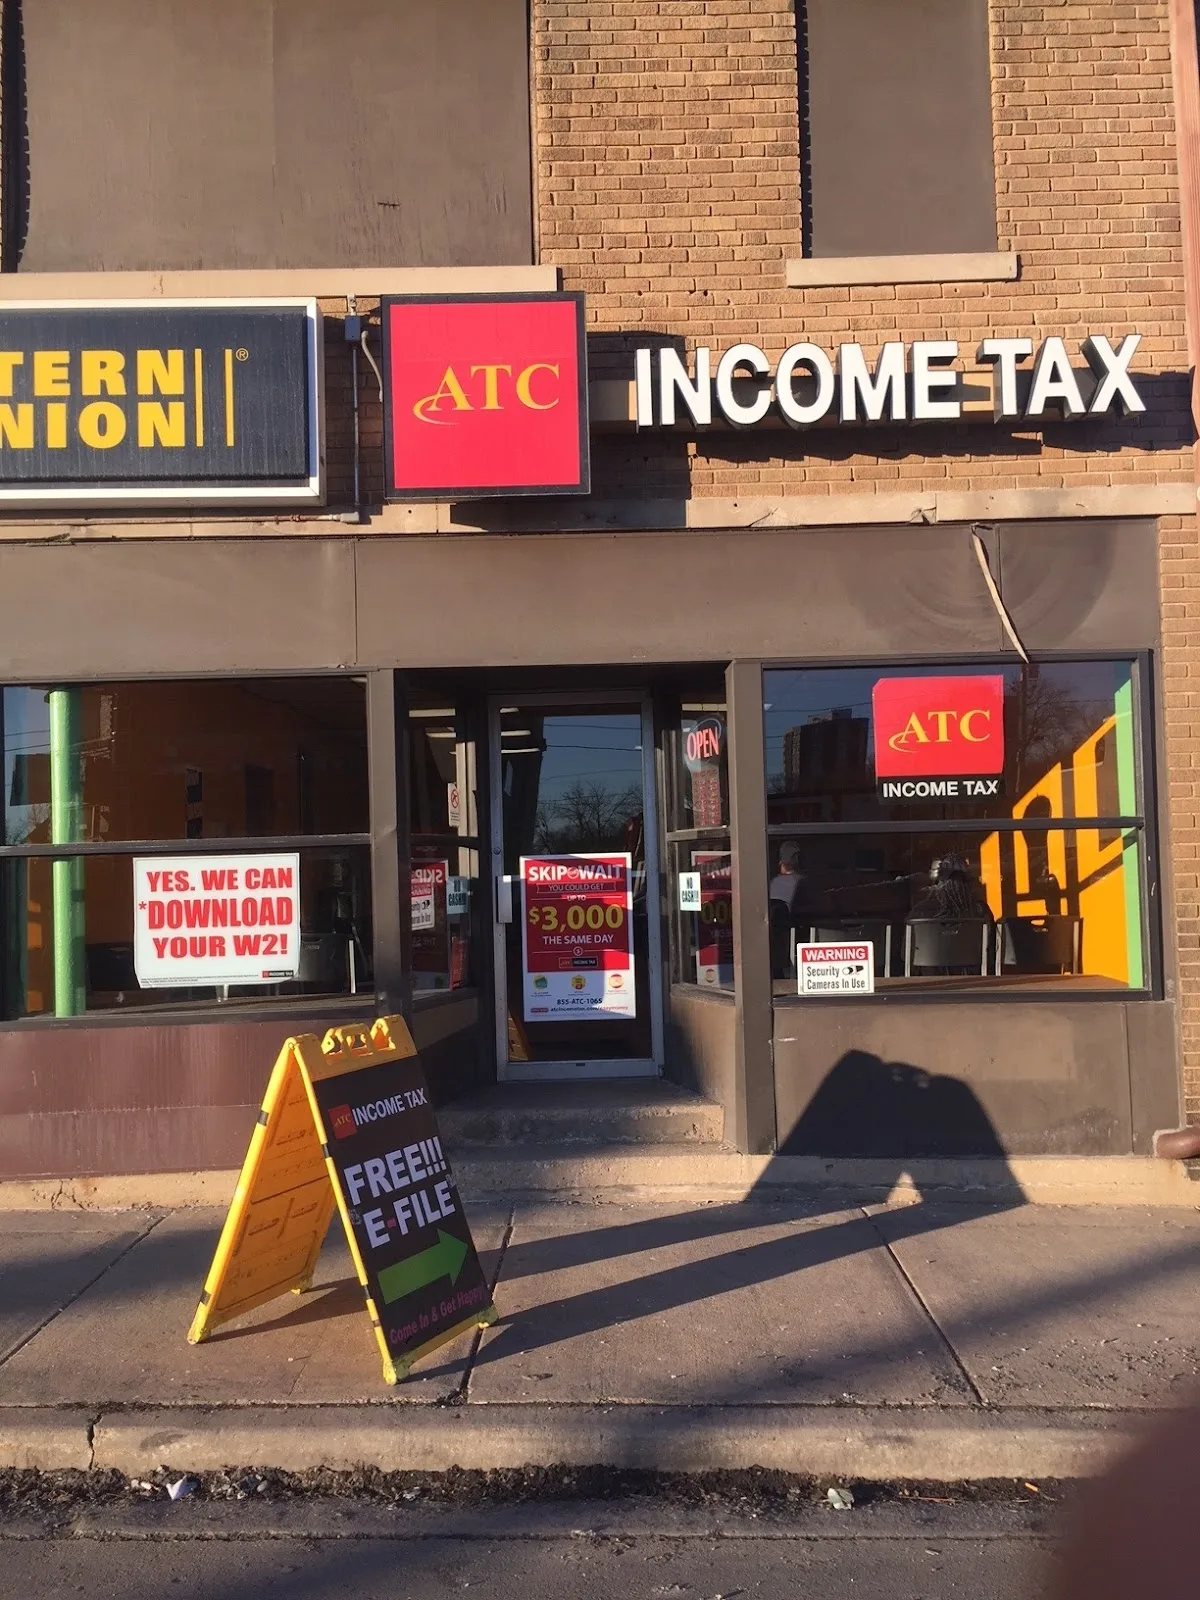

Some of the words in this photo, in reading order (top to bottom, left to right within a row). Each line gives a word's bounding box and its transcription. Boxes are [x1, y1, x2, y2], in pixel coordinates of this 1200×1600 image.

[413, 363, 561, 421] ATC
[635, 340, 961, 427] INCOME
[981, 334, 1146, 418] TAX
[889, 709, 991, 750] ATC
[686, 726, 720, 761] OPEN
[883, 781, 958, 798] INCOME
[963, 779, 998, 796] TAX
[146, 870, 196, 893] YES.
[201, 869, 238, 891] WE
[245, 867, 293, 889] CAN
[529, 865, 567, 882] SKIP
[578, 864, 623, 880] WAIT
[686, 876, 693, 890] NO
[152, 936, 226, 959] YOUR
[233, 933, 288, 957] W2!
[543, 936, 562, 944] THE
[564, 935, 592, 944] SAME
[594, 934, 614, 944] DAY
[804, 947, 867, 961] WARNING
[806, 965, 840, 979] Security
[806, 977, 840, 991] Cameras
[841, 978, 849, 990] In
[851, 977, 866, 990] Use
[334, 1115, 352, 1127] ATC
[352, 1095, 405, 1126] INCOME
[404, 1088, 428, 1109] TAX
[343, 1136, 447, 1206] FREE!!!
[363, 1180, 456, 1249] E-FILE
[389, 1319, 419, 1345] Come
[419, 1315, 429, 1329] In
[431, 1306, 439, 1322] &
[440, 1296, 457, 1317] Get
